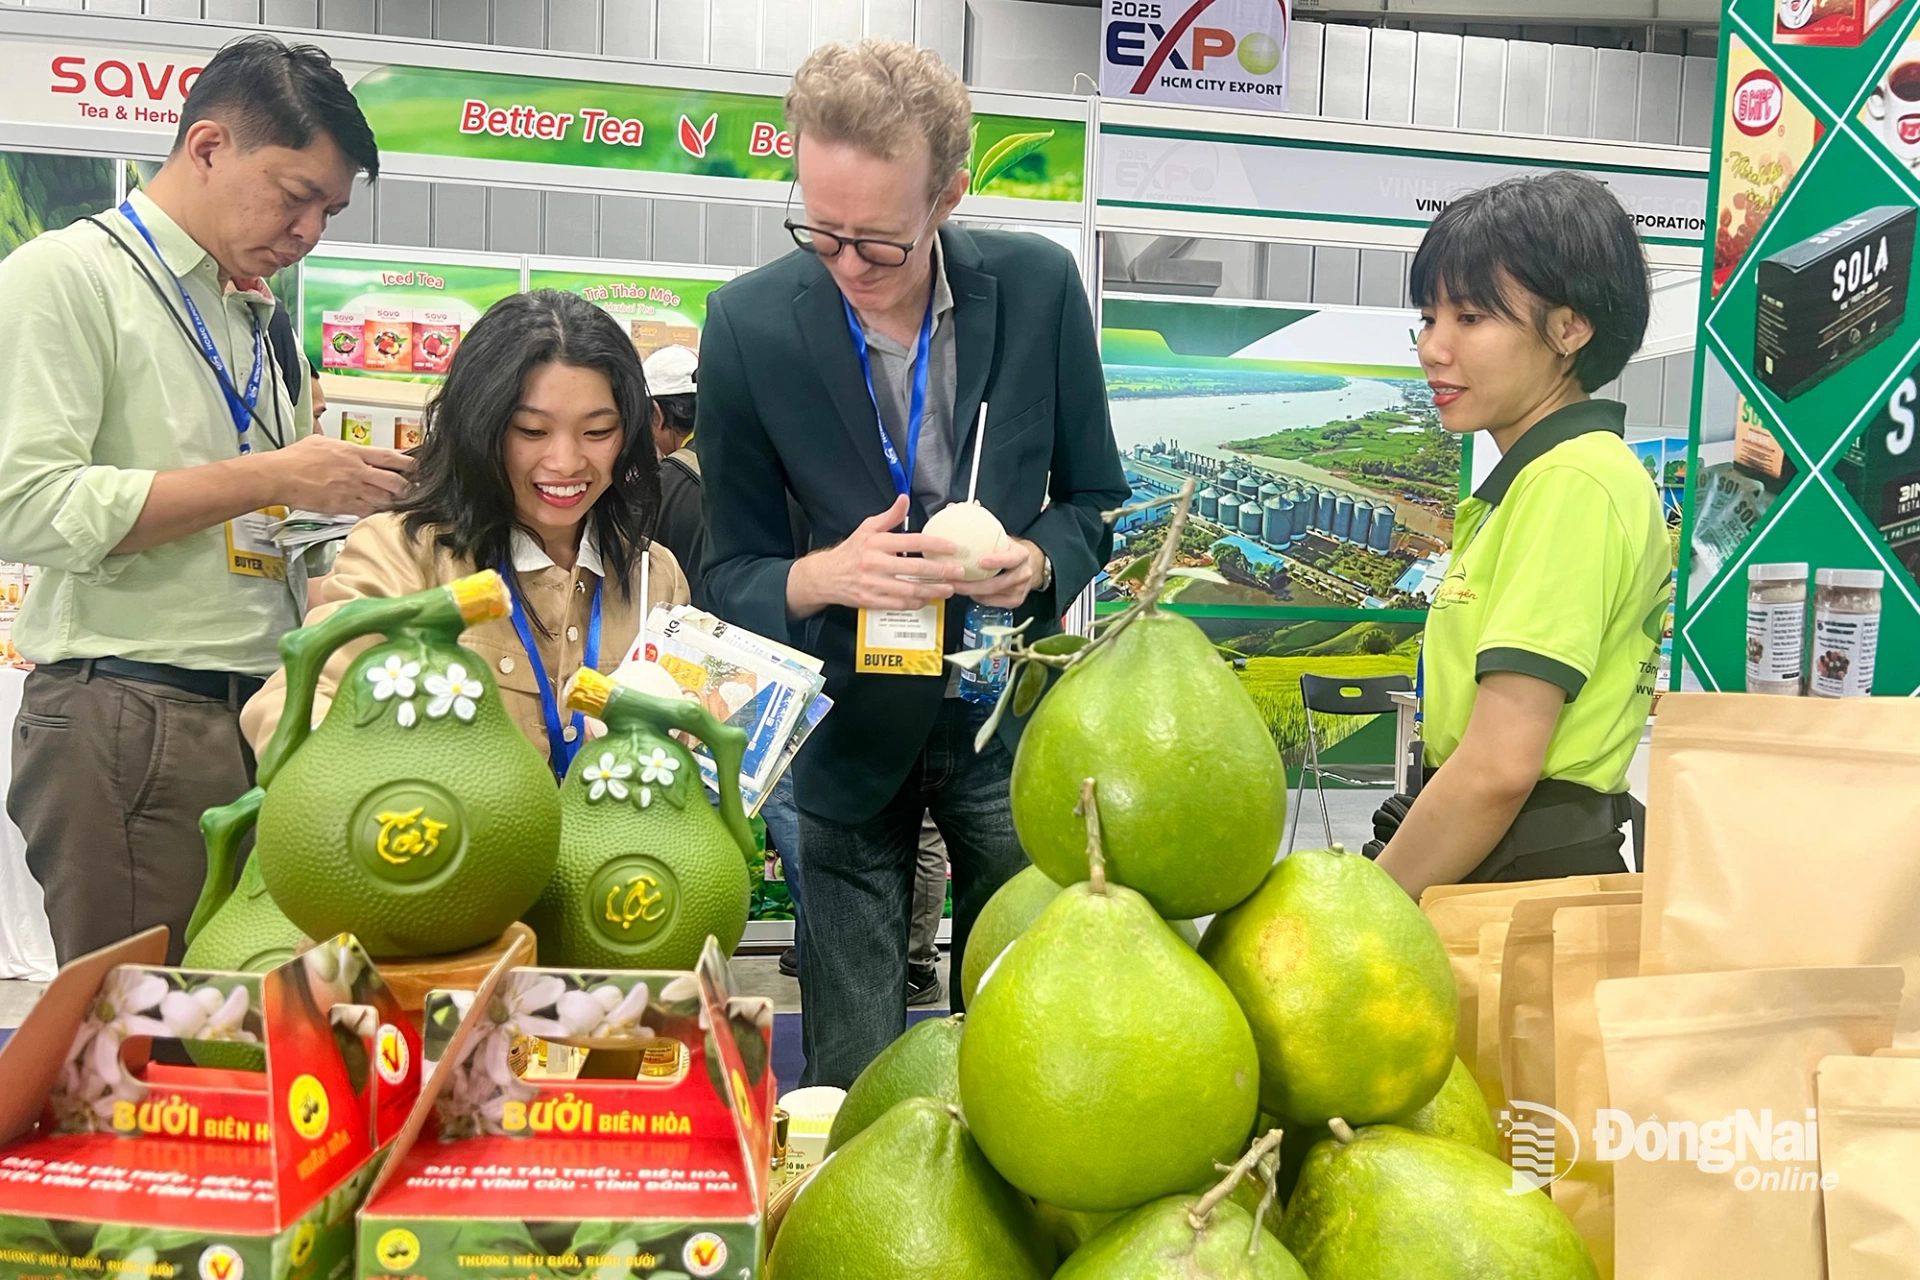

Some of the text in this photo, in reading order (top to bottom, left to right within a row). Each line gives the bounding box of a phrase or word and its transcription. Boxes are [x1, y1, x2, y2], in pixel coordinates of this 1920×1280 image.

[1112, 0, 1161, 18] 2025
[1106, 20, 1281, 76] EXPO
[1161, 77, 1283, 95] HCM CITY EXPORT
[78, 102, 179, 124] Tea & Herb
[461, 100, 573, 140] Better
[580, 107, 643, 146] Tea
[1808, 218, 1868, 244] SOLA
[382, 271, 444, 289] Iced Tea
[1831, 235, 1889, 302] SOLA
[584, 283, 681, 306] Trà Thảo Mộc
[234, 555, 263, 570] BUYER
[864, 653, 904, 667] BUYER
[112, 1094, 199, 1137] BƯỞI
[203, 1115, 250, 1141] BIÊN
[503, 1092, 691, 1135] BƯỞI BIÊN HÒA
